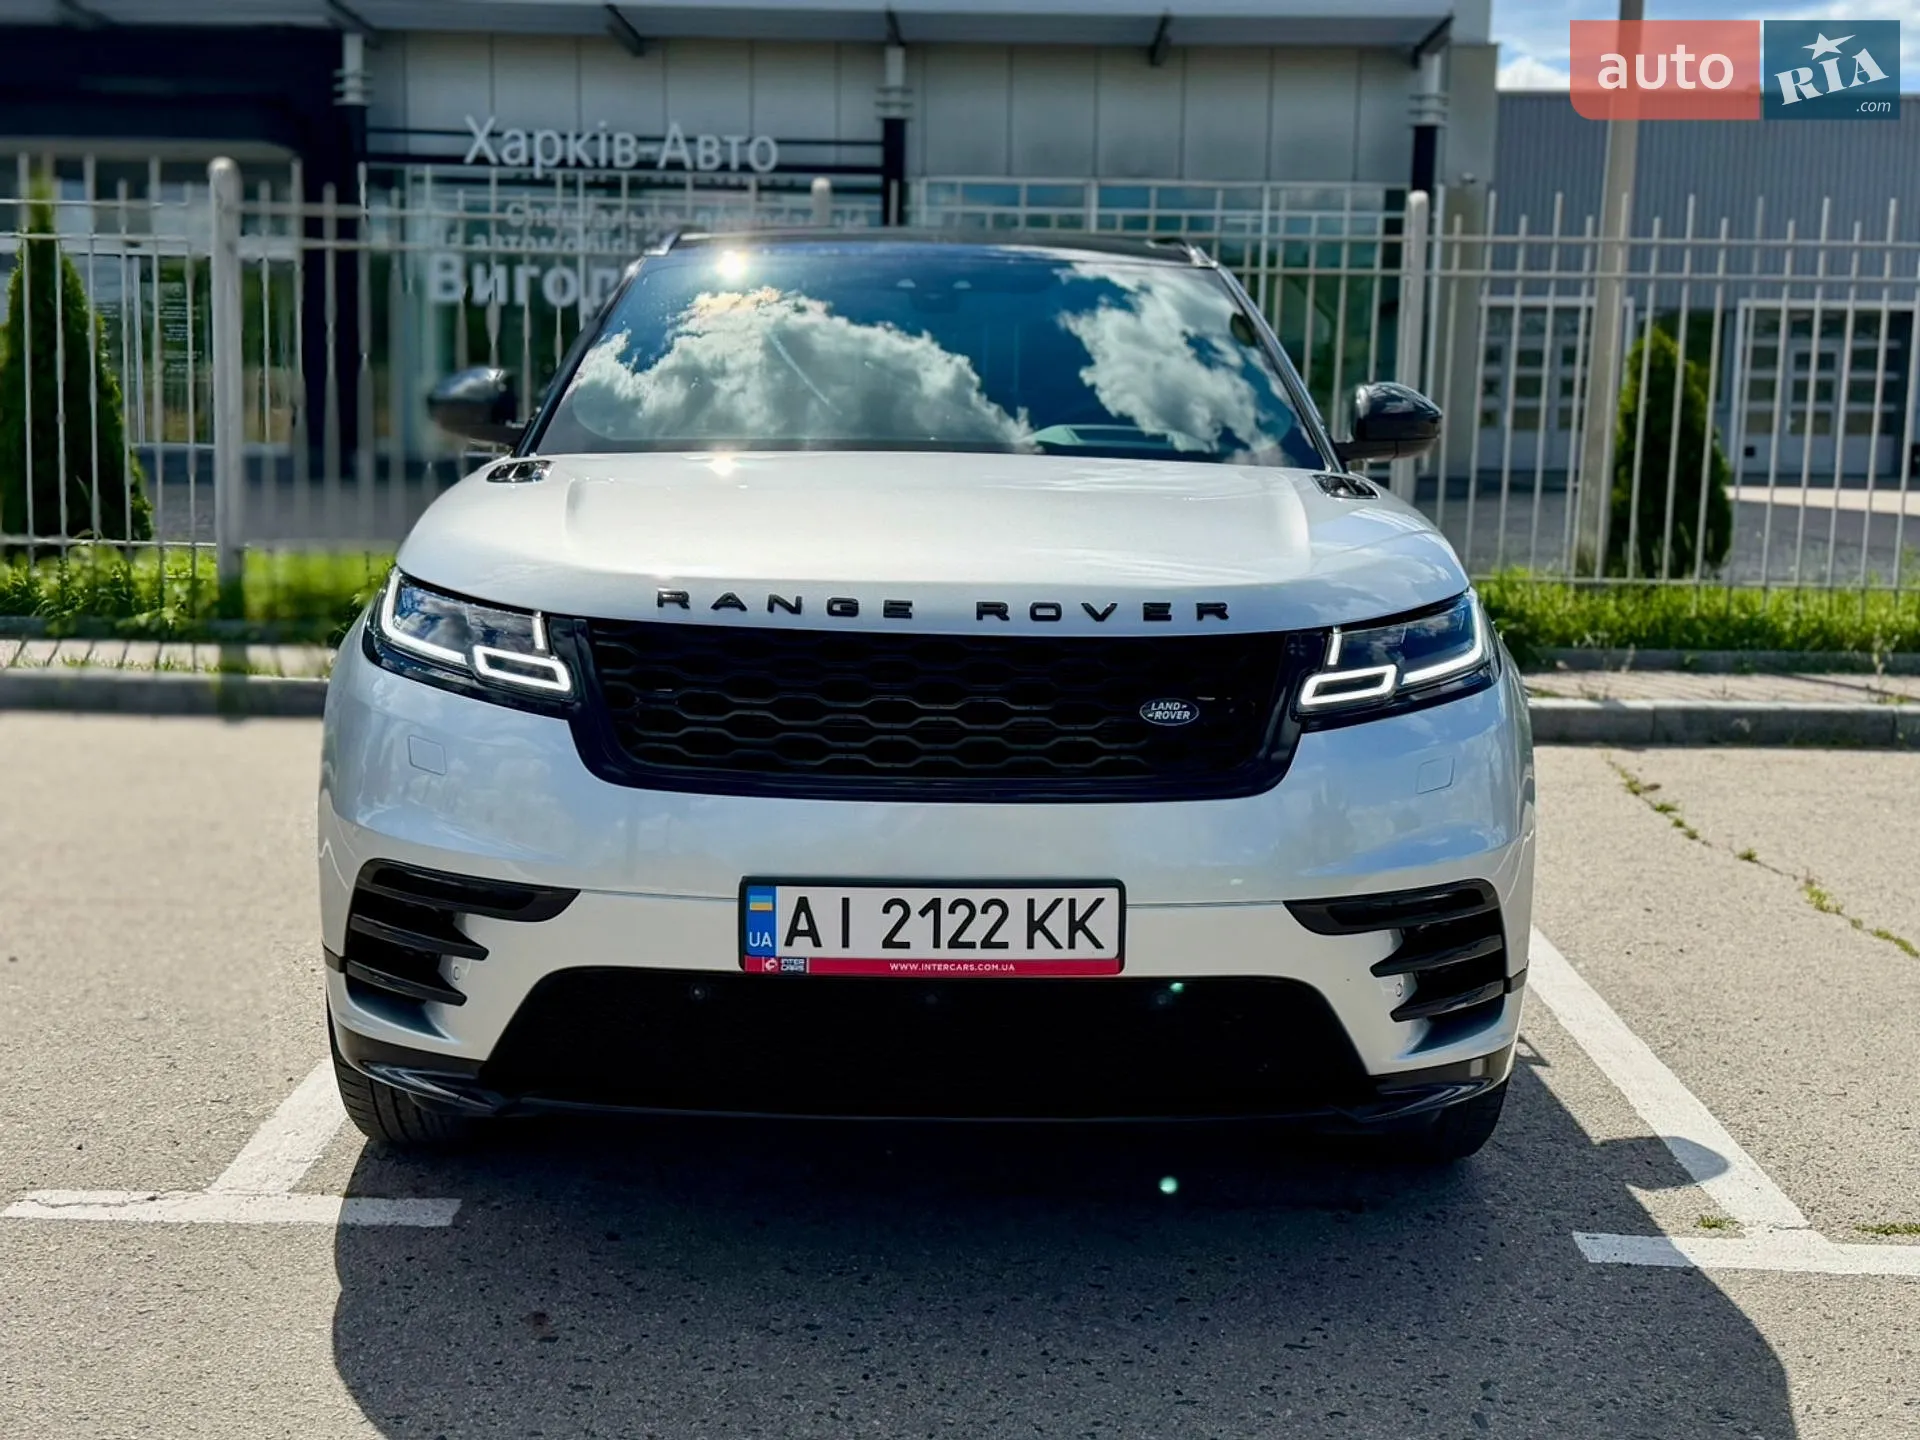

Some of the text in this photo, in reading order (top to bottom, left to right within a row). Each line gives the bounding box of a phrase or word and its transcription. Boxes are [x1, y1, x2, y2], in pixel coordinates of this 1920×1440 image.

[464, 114, 778, 179] Харків-Авто
[657, 589, 1230, 622] RANGE ROVER
[749, 931, 773, 948] UA
[783, 896, 1106, 950] AI 2122 KK
[889, 962, 1016, 972] WWW.INTERCARS.COM.UA
